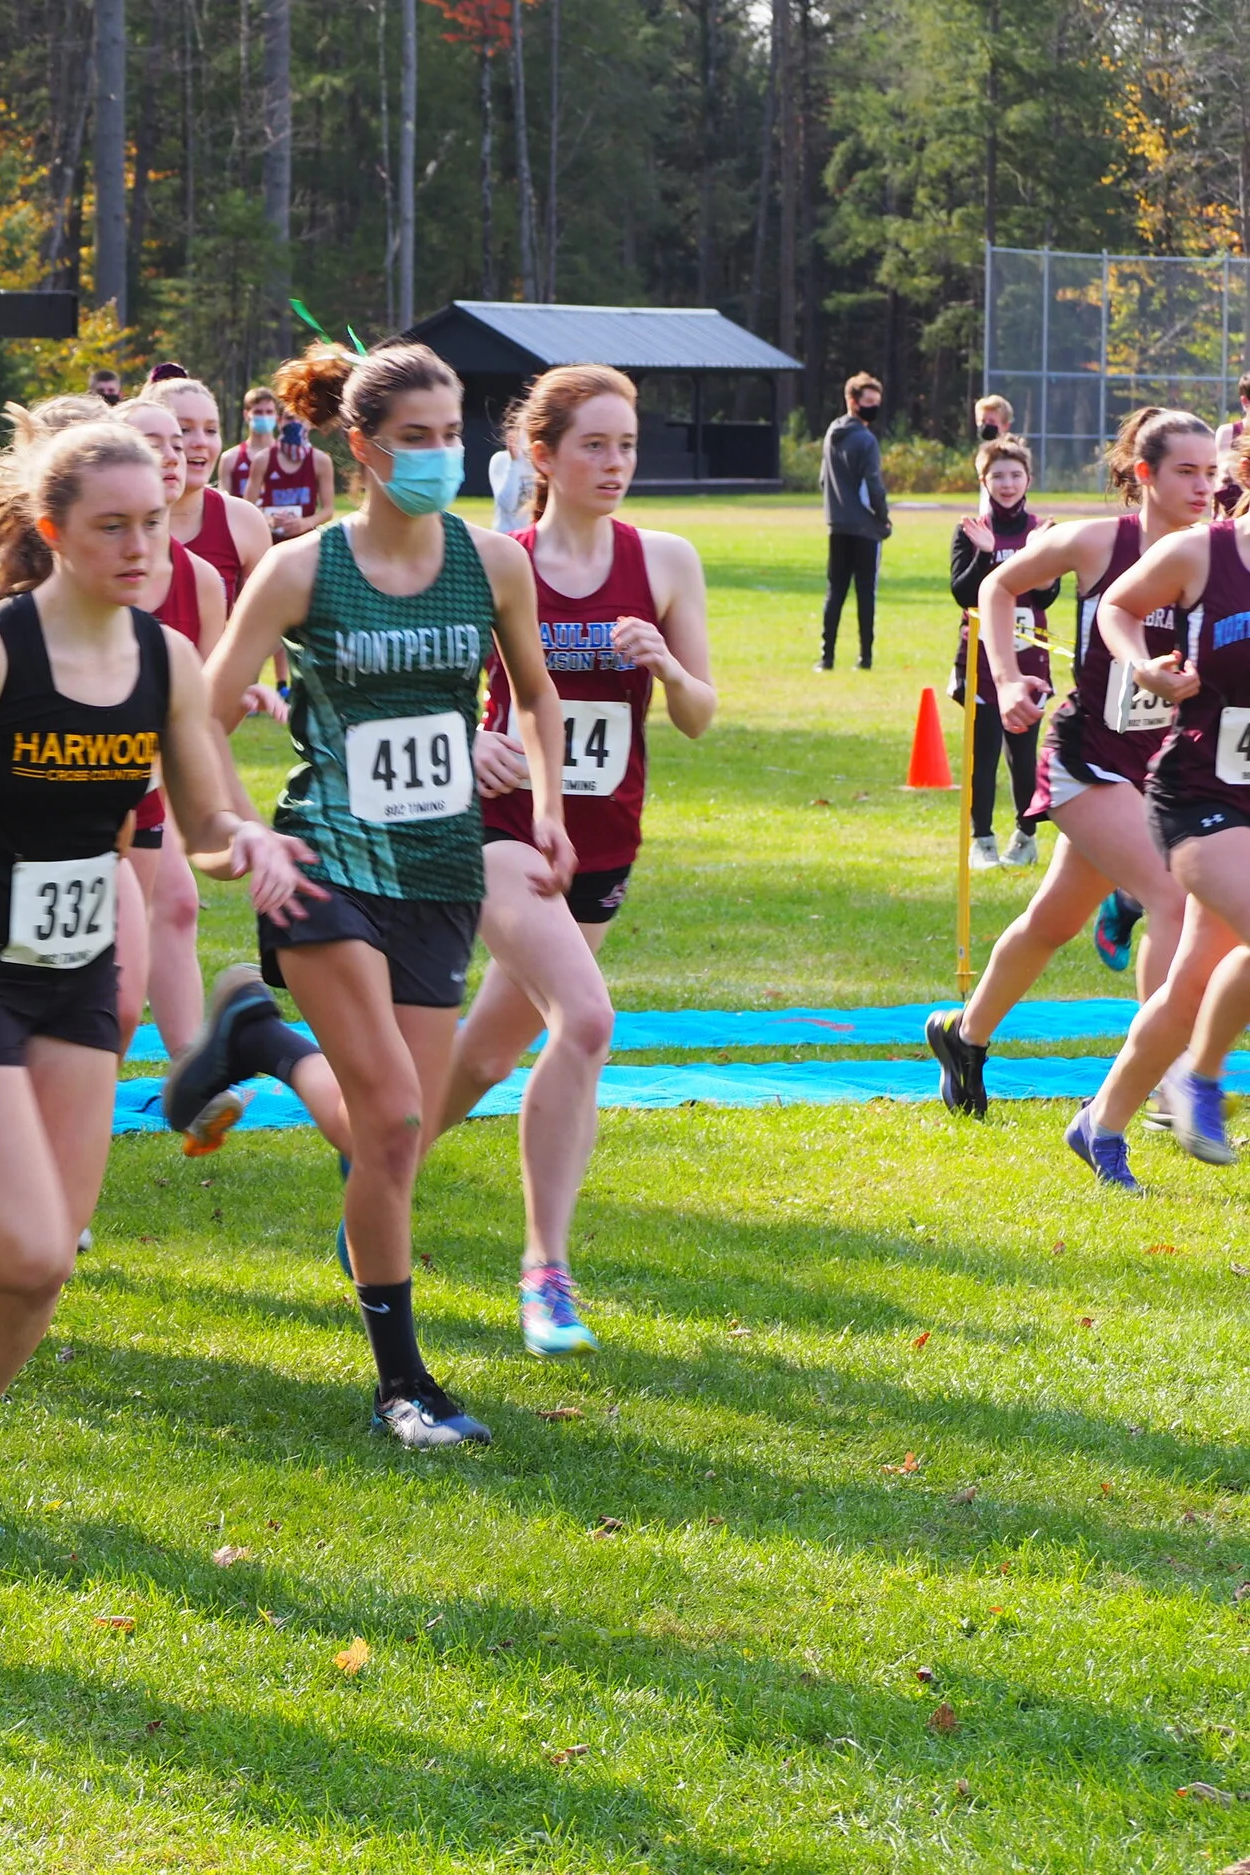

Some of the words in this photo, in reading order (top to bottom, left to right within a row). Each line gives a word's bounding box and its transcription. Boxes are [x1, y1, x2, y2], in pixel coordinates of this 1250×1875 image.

[540, 622, 616, 650] AULDI
[1145, 607, 1175, 630] BRA
[334, 624, 481, 687] MONTPELIER
[372, 734, 453, 792] 419
[563, 717, 610, 769] 14
[1236, 721, 1250, 763] 4
[35, 877, 106, 941] 332
